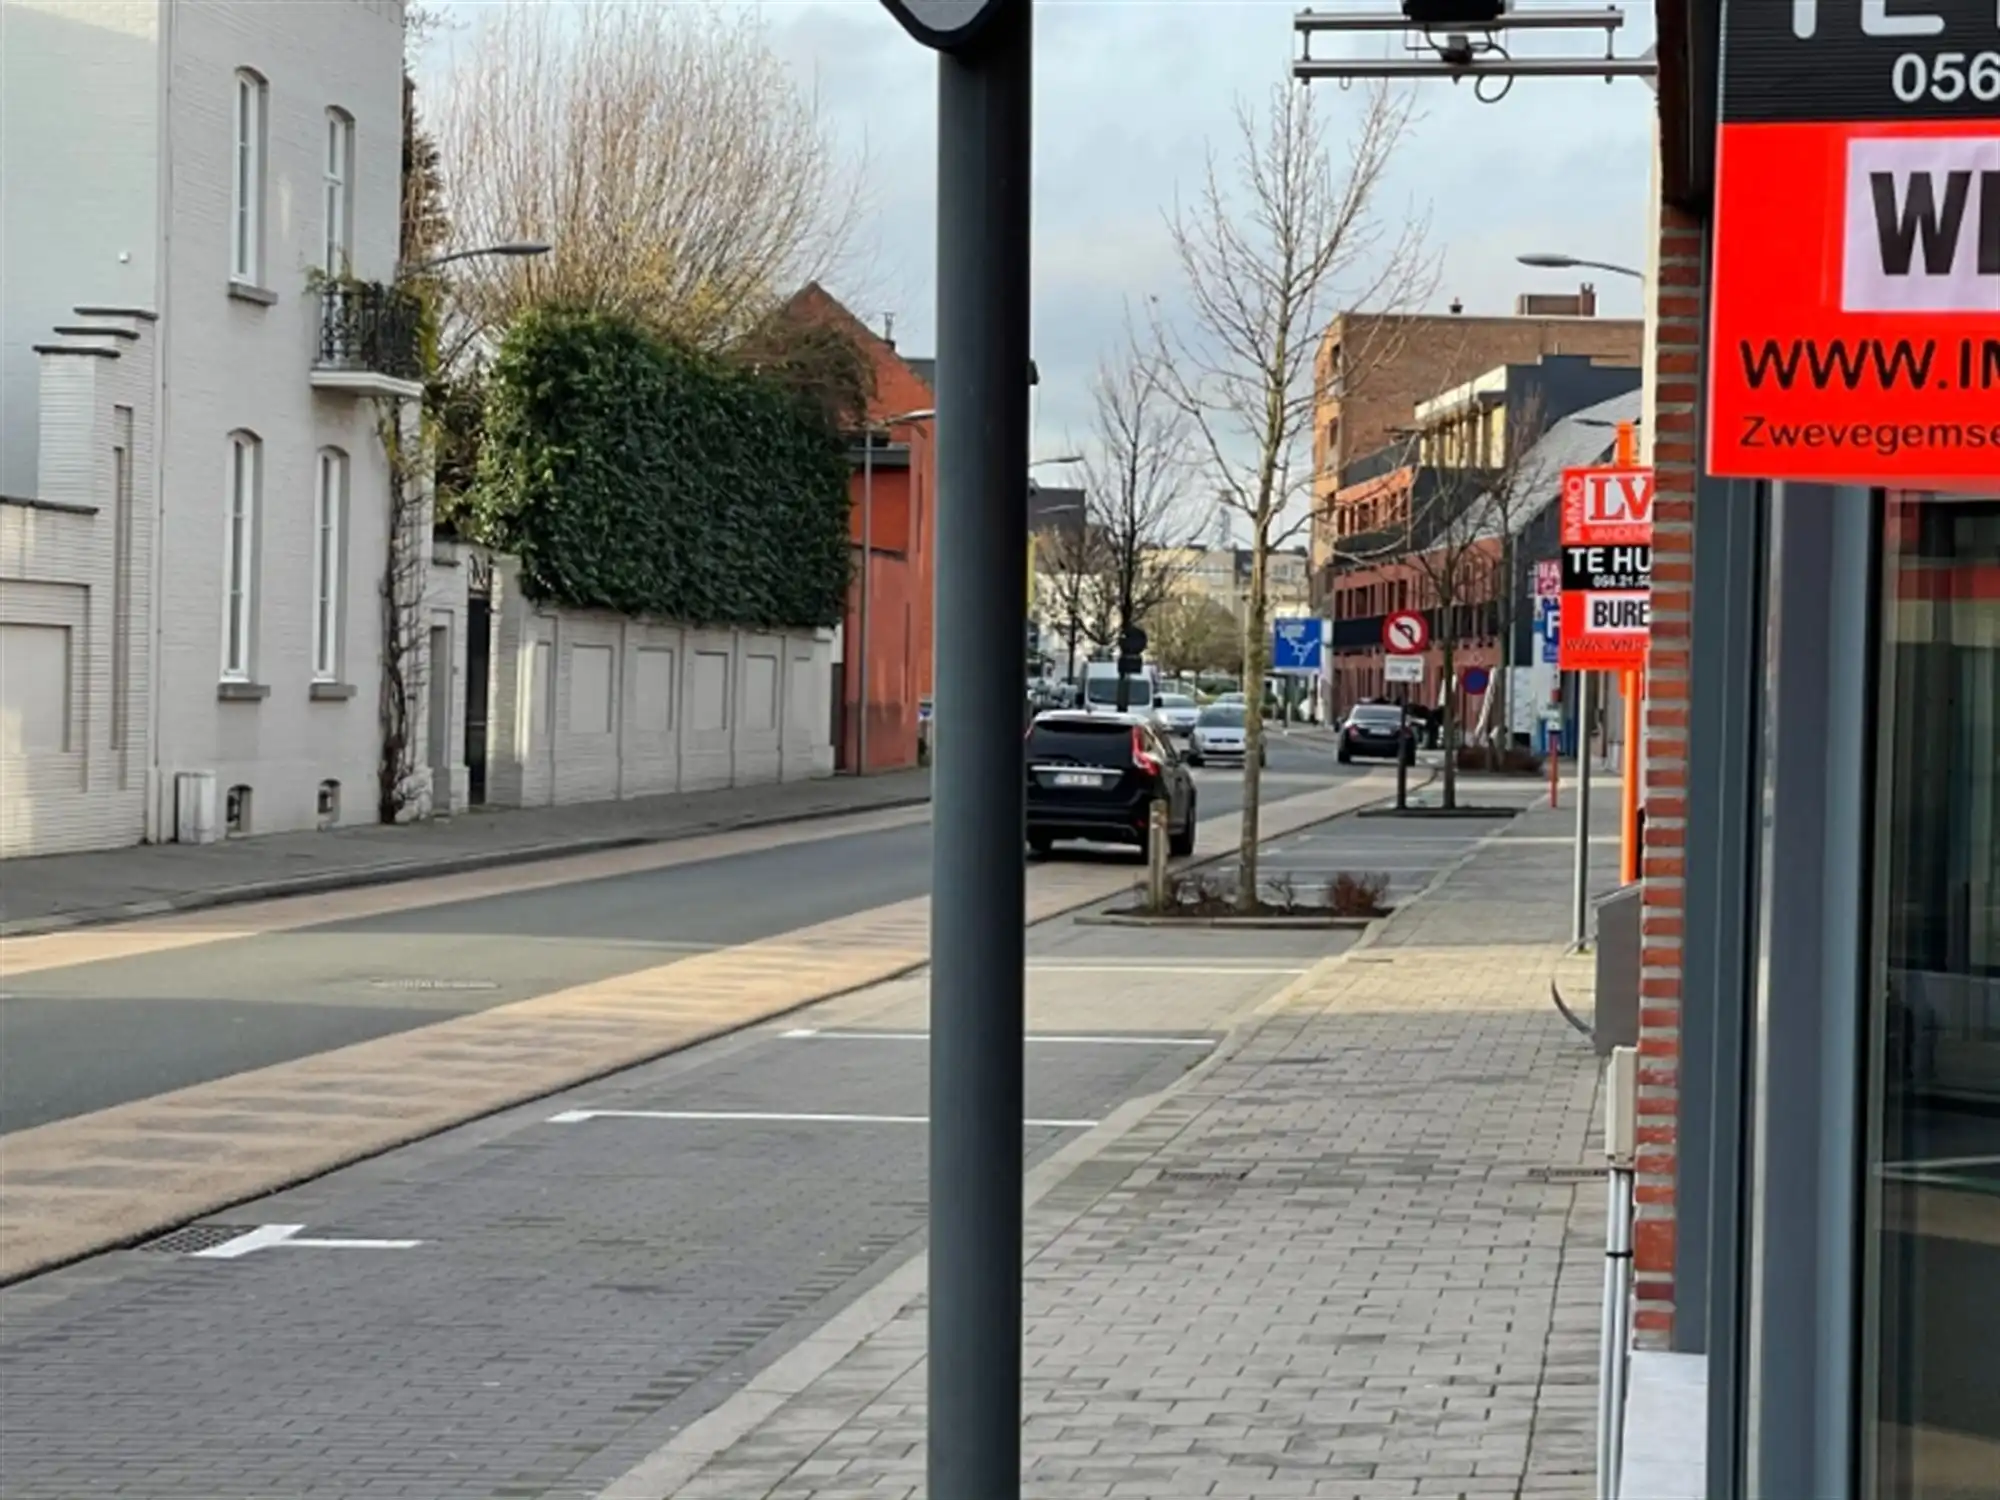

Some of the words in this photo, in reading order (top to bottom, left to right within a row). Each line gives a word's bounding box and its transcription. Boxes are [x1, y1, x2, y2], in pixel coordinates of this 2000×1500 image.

[1892, 52, 2000, 102] 056
[1588, 477, 1653, 520] LV
[1567, 547, 1604, 574] TE
[1612, 547, 1652, 574] HU
[1593, 600, 1649, 628] BURE
